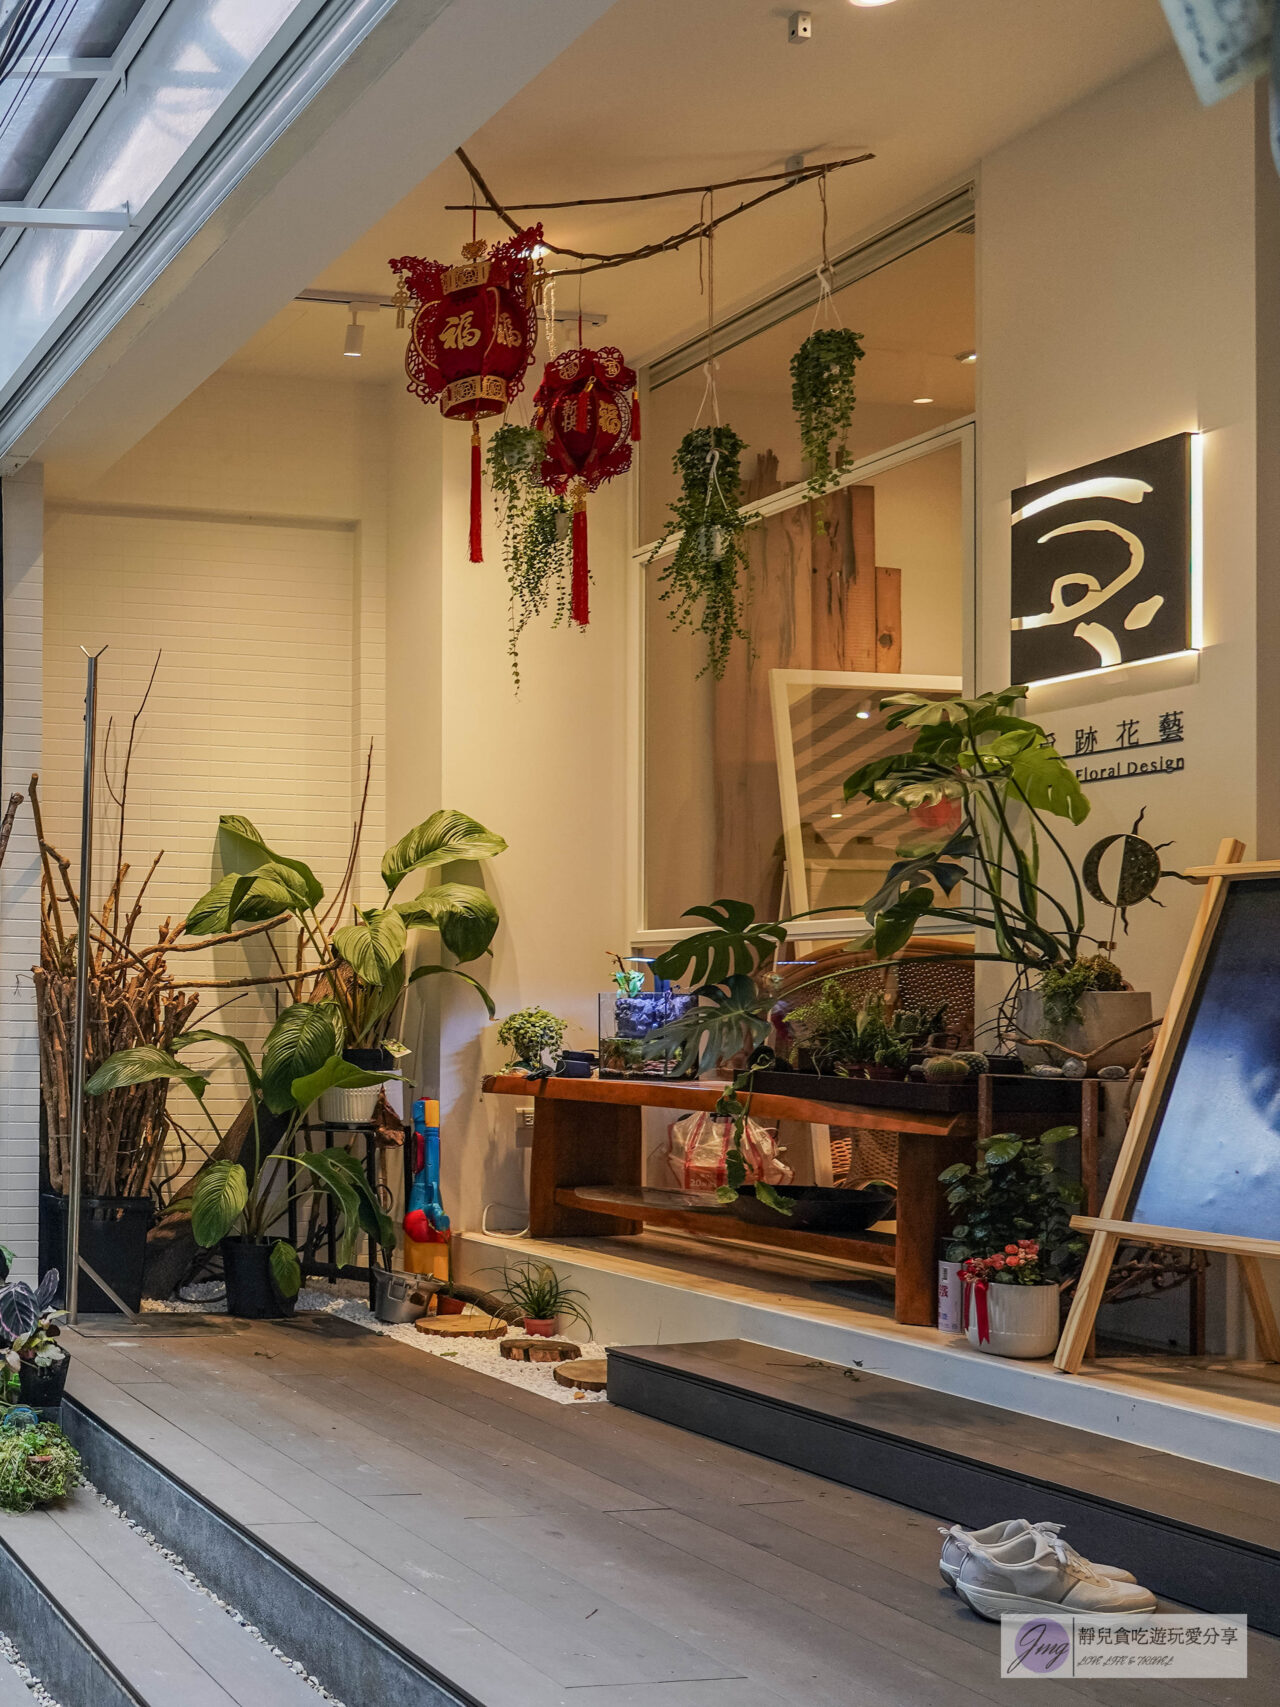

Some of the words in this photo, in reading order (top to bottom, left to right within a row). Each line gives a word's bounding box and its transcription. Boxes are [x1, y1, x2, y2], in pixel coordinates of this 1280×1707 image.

[439, 311, 480, 350] 福
[1076, 762, 1121, 780] Floral
[1127, 756, 1185, 775] Design
